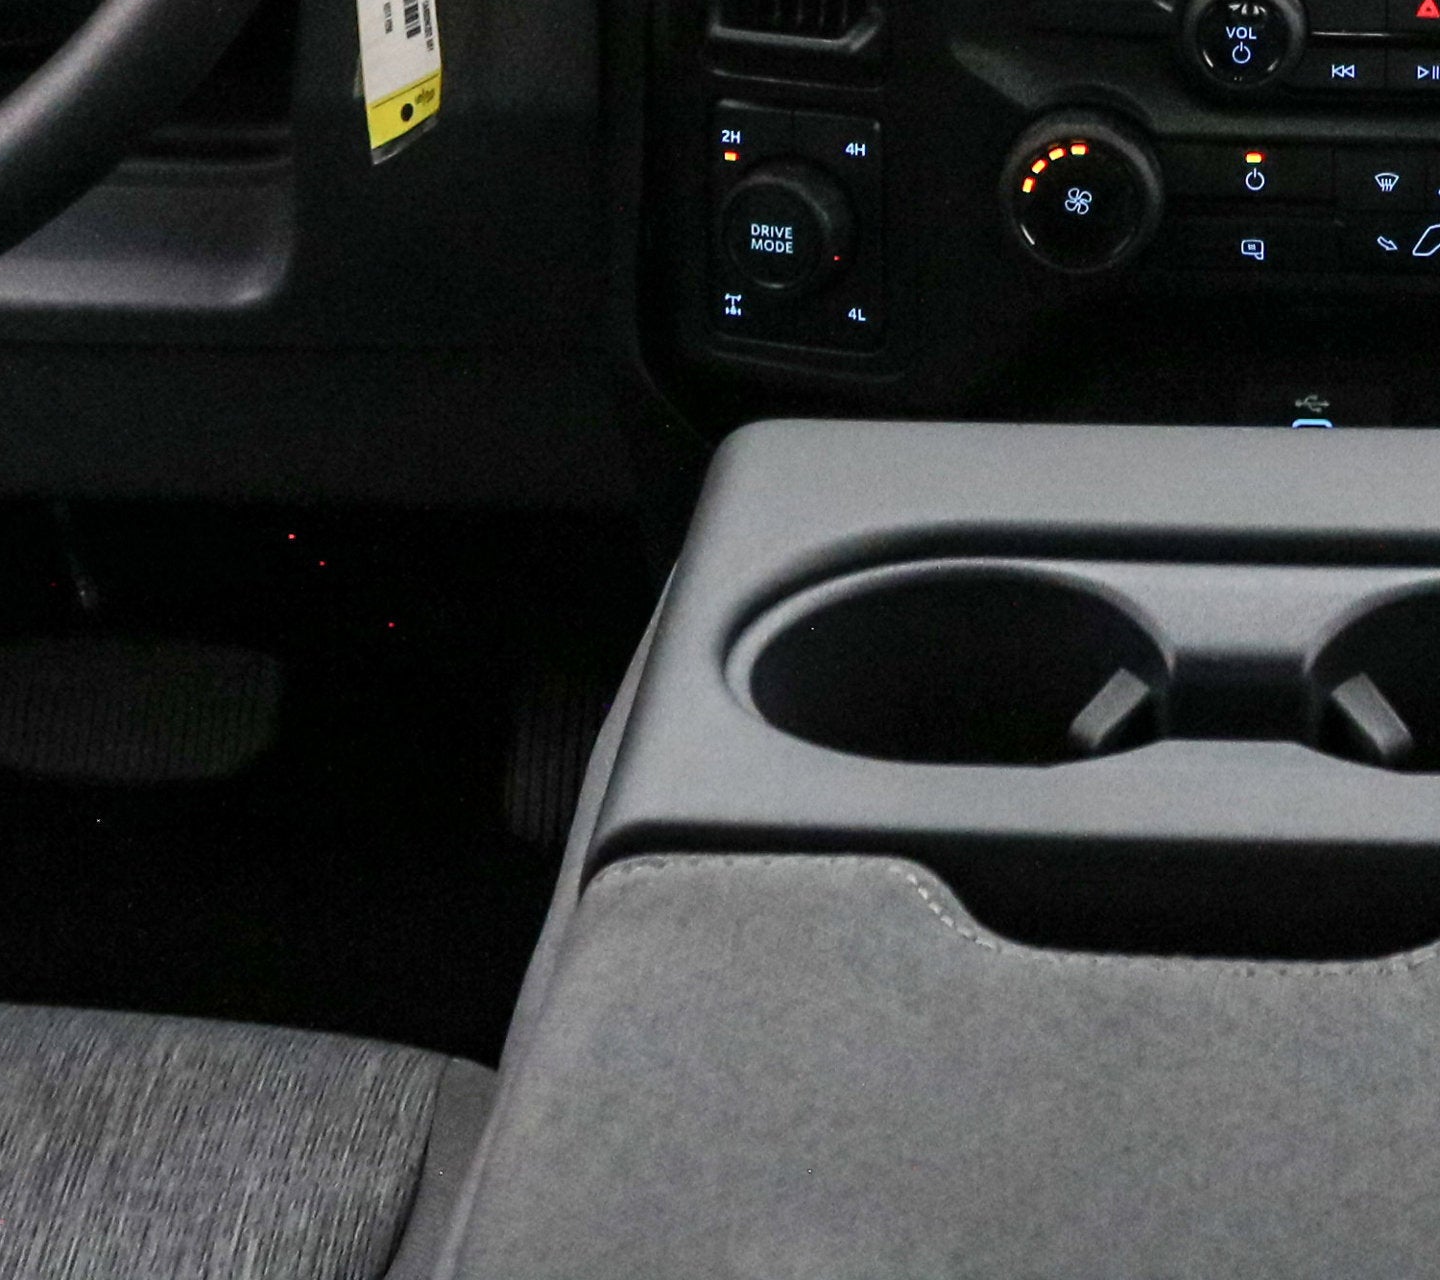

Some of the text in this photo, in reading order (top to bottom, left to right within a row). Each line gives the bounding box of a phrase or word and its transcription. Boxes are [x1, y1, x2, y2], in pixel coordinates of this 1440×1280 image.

[1226, 26, 1257, 40] VOL
[721, 130, 741, 144] 2H
[845, 143, 866, 156] 4H
[750, 223, 793, 239] DRIVE
[750, 238, 793, 254] MODE
[848, 307, 866, 322] 4L
